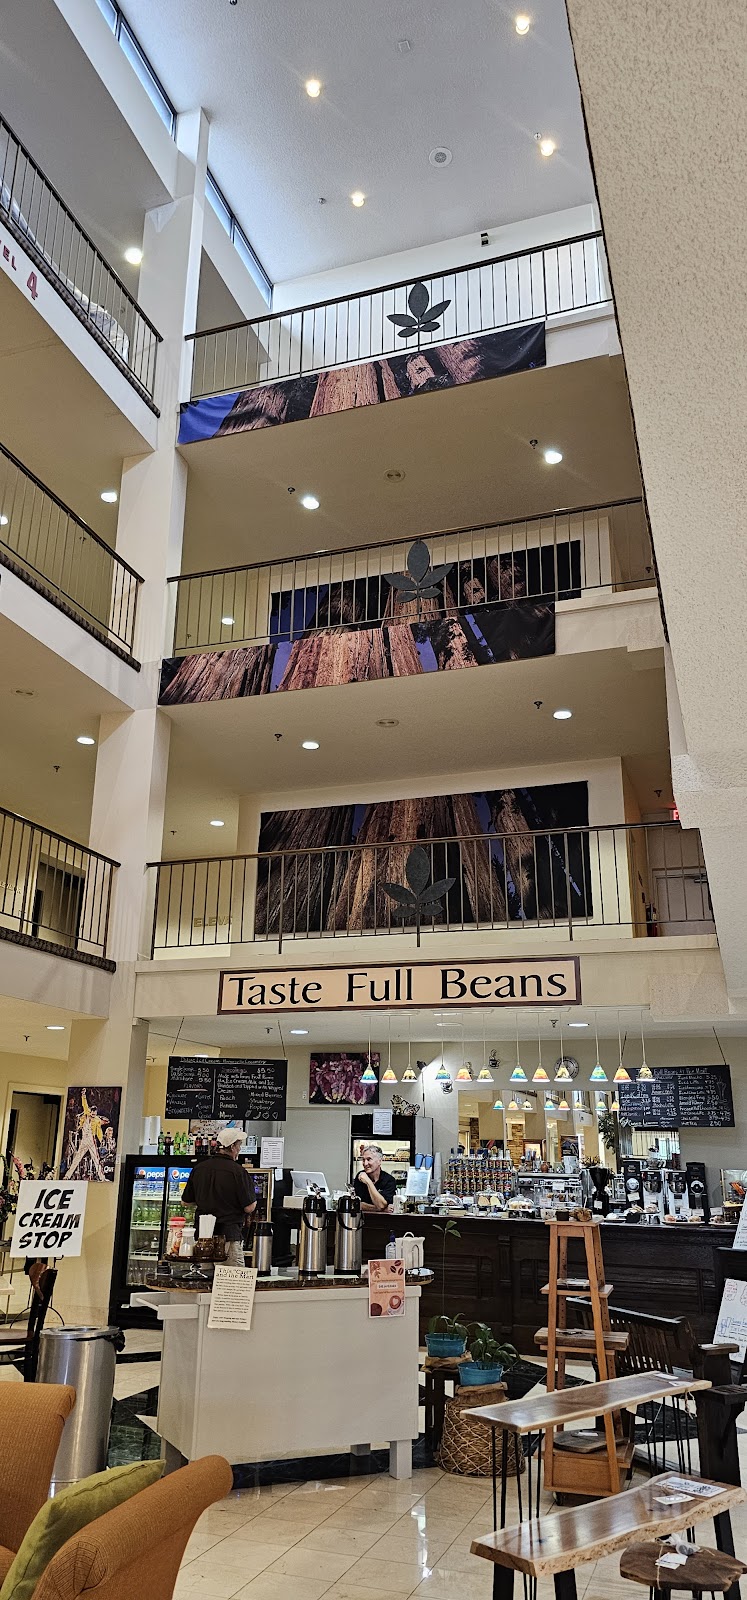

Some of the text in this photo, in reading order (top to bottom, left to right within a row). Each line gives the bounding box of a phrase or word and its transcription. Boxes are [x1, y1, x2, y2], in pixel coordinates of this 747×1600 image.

[0, 239, 38, 300] EL 4
[228, 968, 568, 1006] Taste Full Beans
[34, 1189, 74, 1210] ICE
[19, 1213, 81, 1229] CREAM
[19, 1231, 73, 1248] STOP
